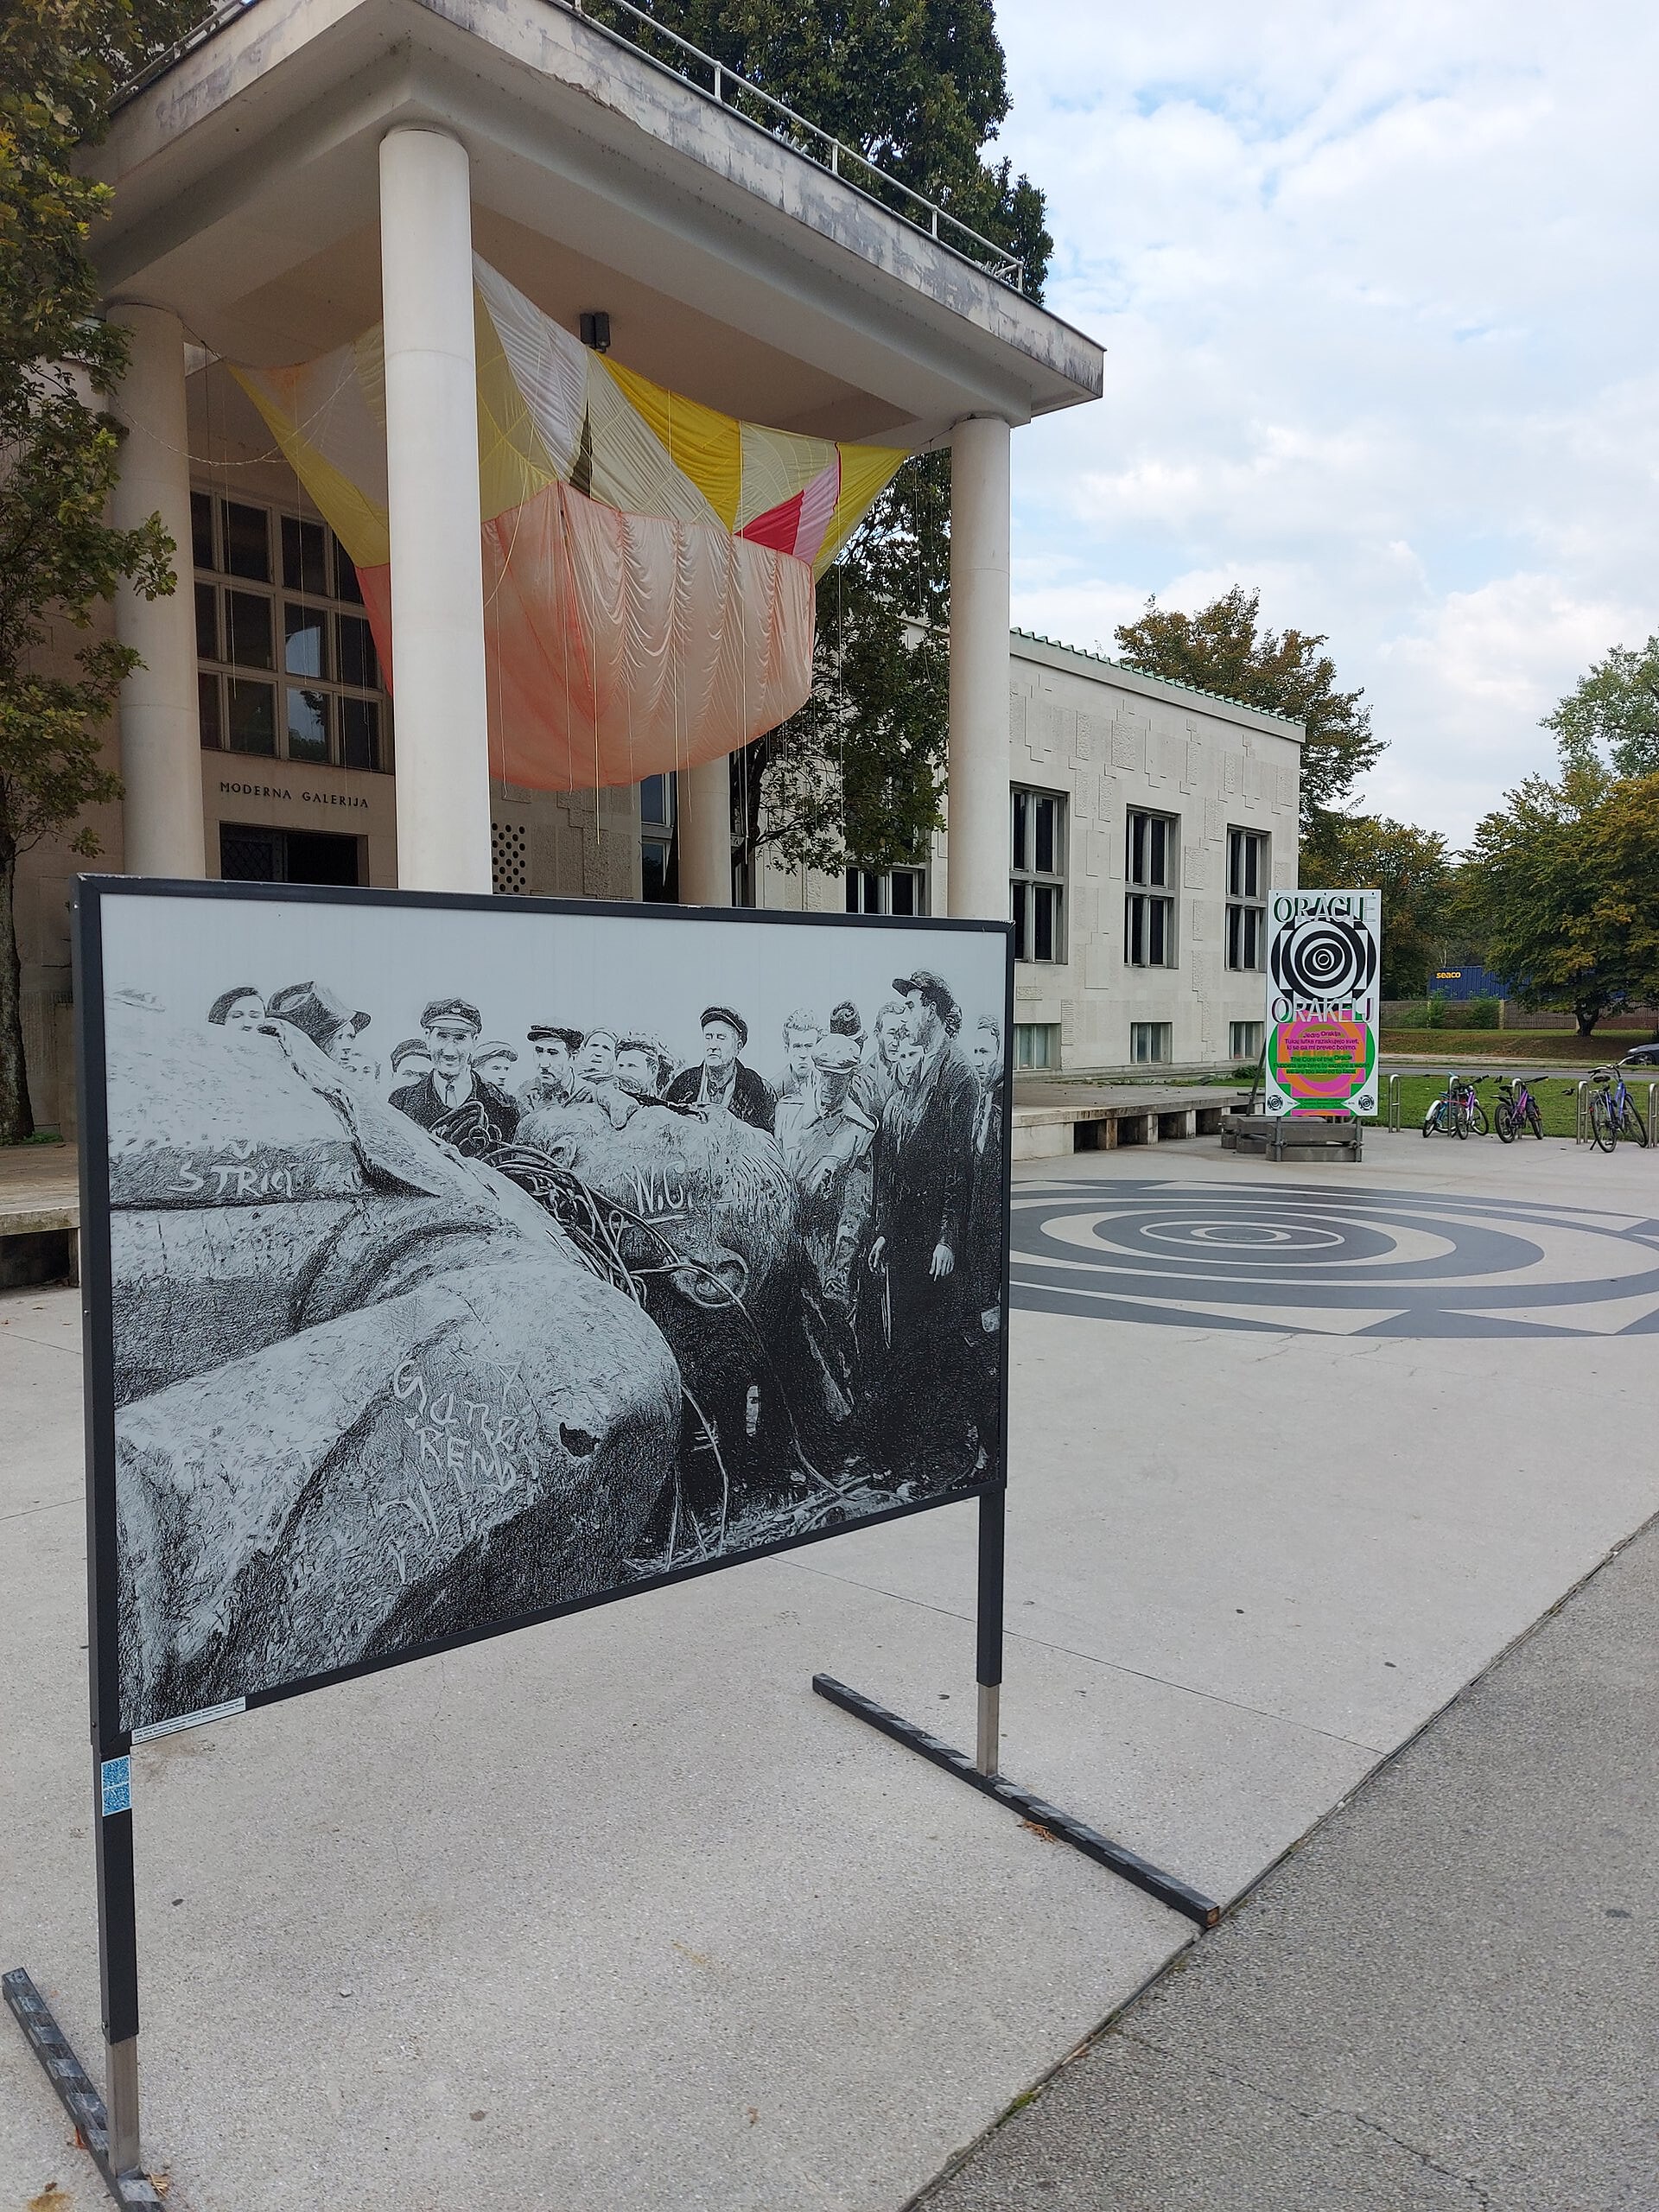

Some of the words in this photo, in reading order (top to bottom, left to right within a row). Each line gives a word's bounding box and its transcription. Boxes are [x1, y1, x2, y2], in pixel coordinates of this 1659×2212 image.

[220, 782, 292, 799] MODERNA
[302, 791, 368, 808] GALERIJA
[1274, 896, 1376, 923] ORACLE
[1272, 997, 1374, 1023] ORAKELJ
